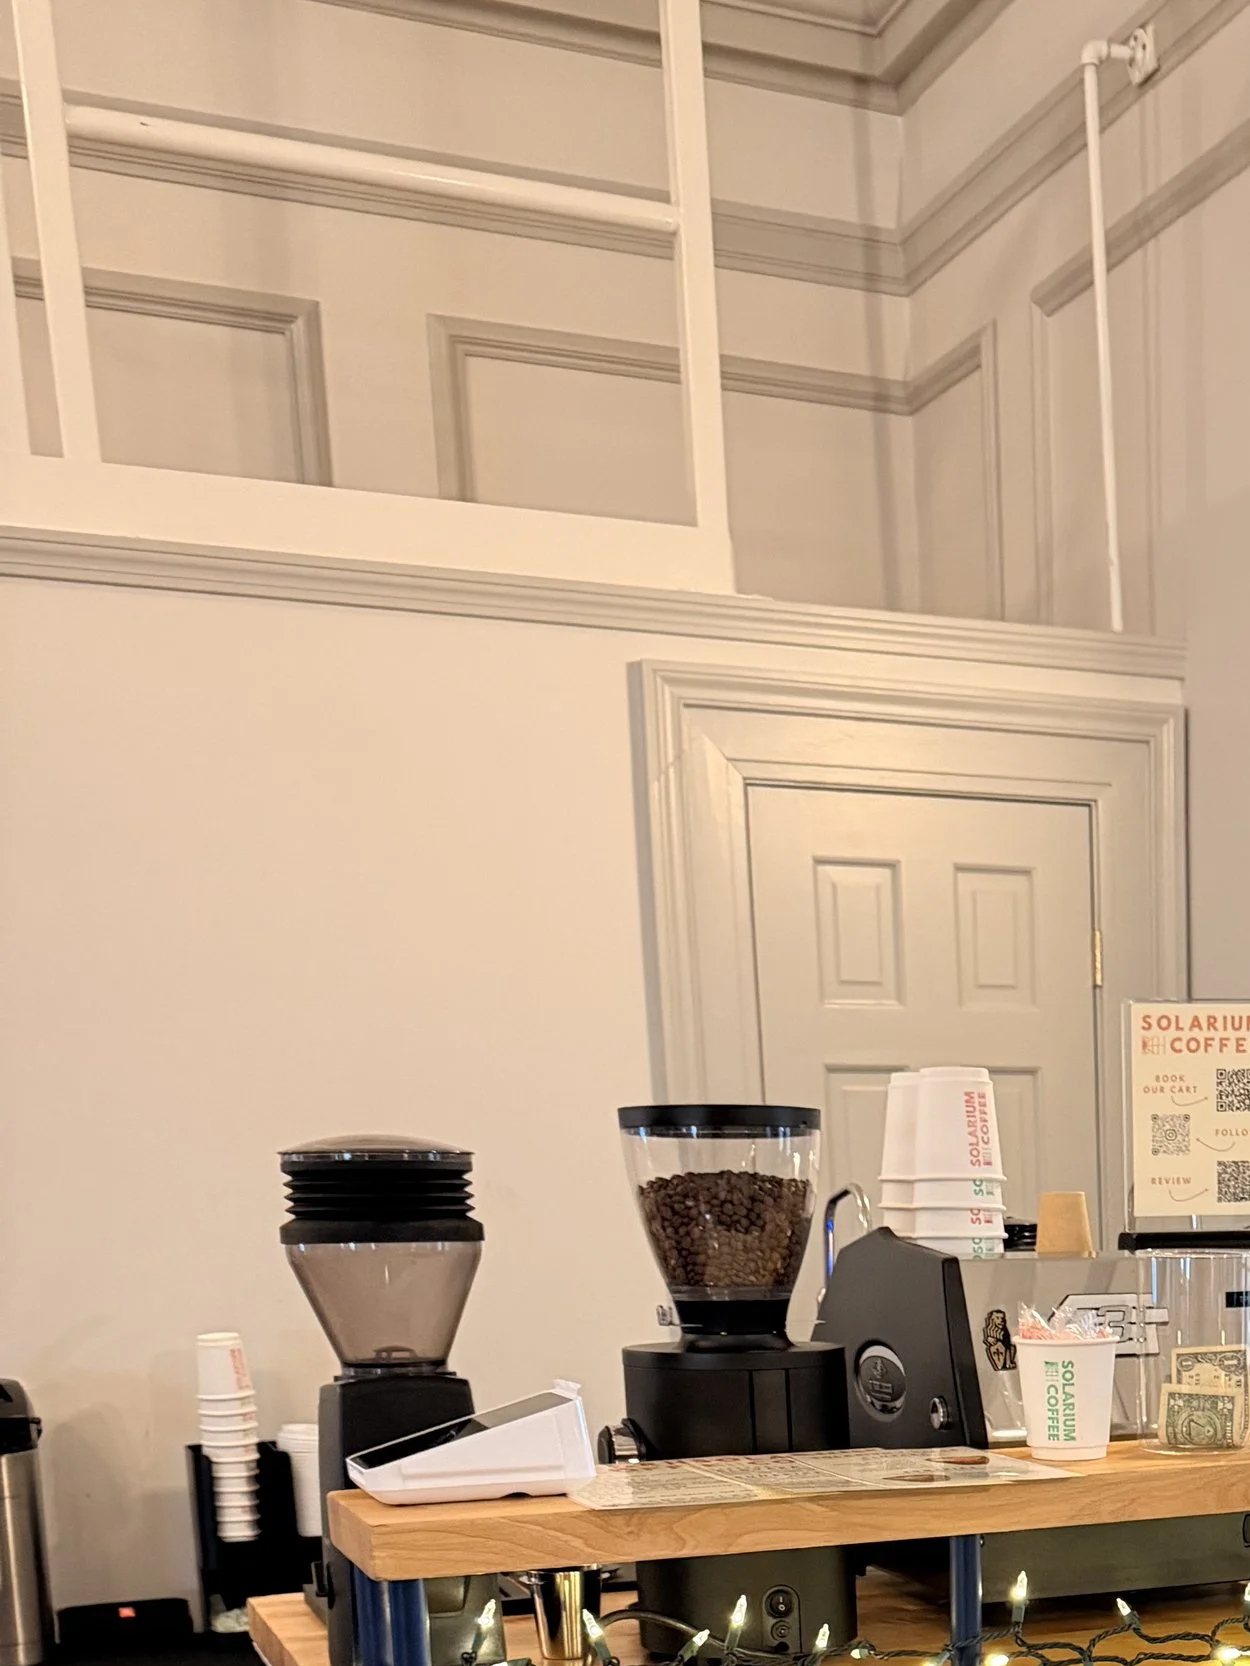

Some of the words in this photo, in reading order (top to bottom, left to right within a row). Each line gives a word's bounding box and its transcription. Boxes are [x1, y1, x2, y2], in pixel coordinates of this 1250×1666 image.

[1143, 1085, 1165, 1094] OUR
[1170, 1085, 1198, 1094] CART
[1155, 1074, 1185, 1083] BOOK
[964, 1091, 981, 1167] SOLARIUM
[978, 1092, 990, 1145] COFFEE
[1150, 1177, 1191, 1186] REVIEW
[1046, 1384, 1059, 1441] COFFEE
[1062, 1360, 1076, 1441] SOLARIUM
